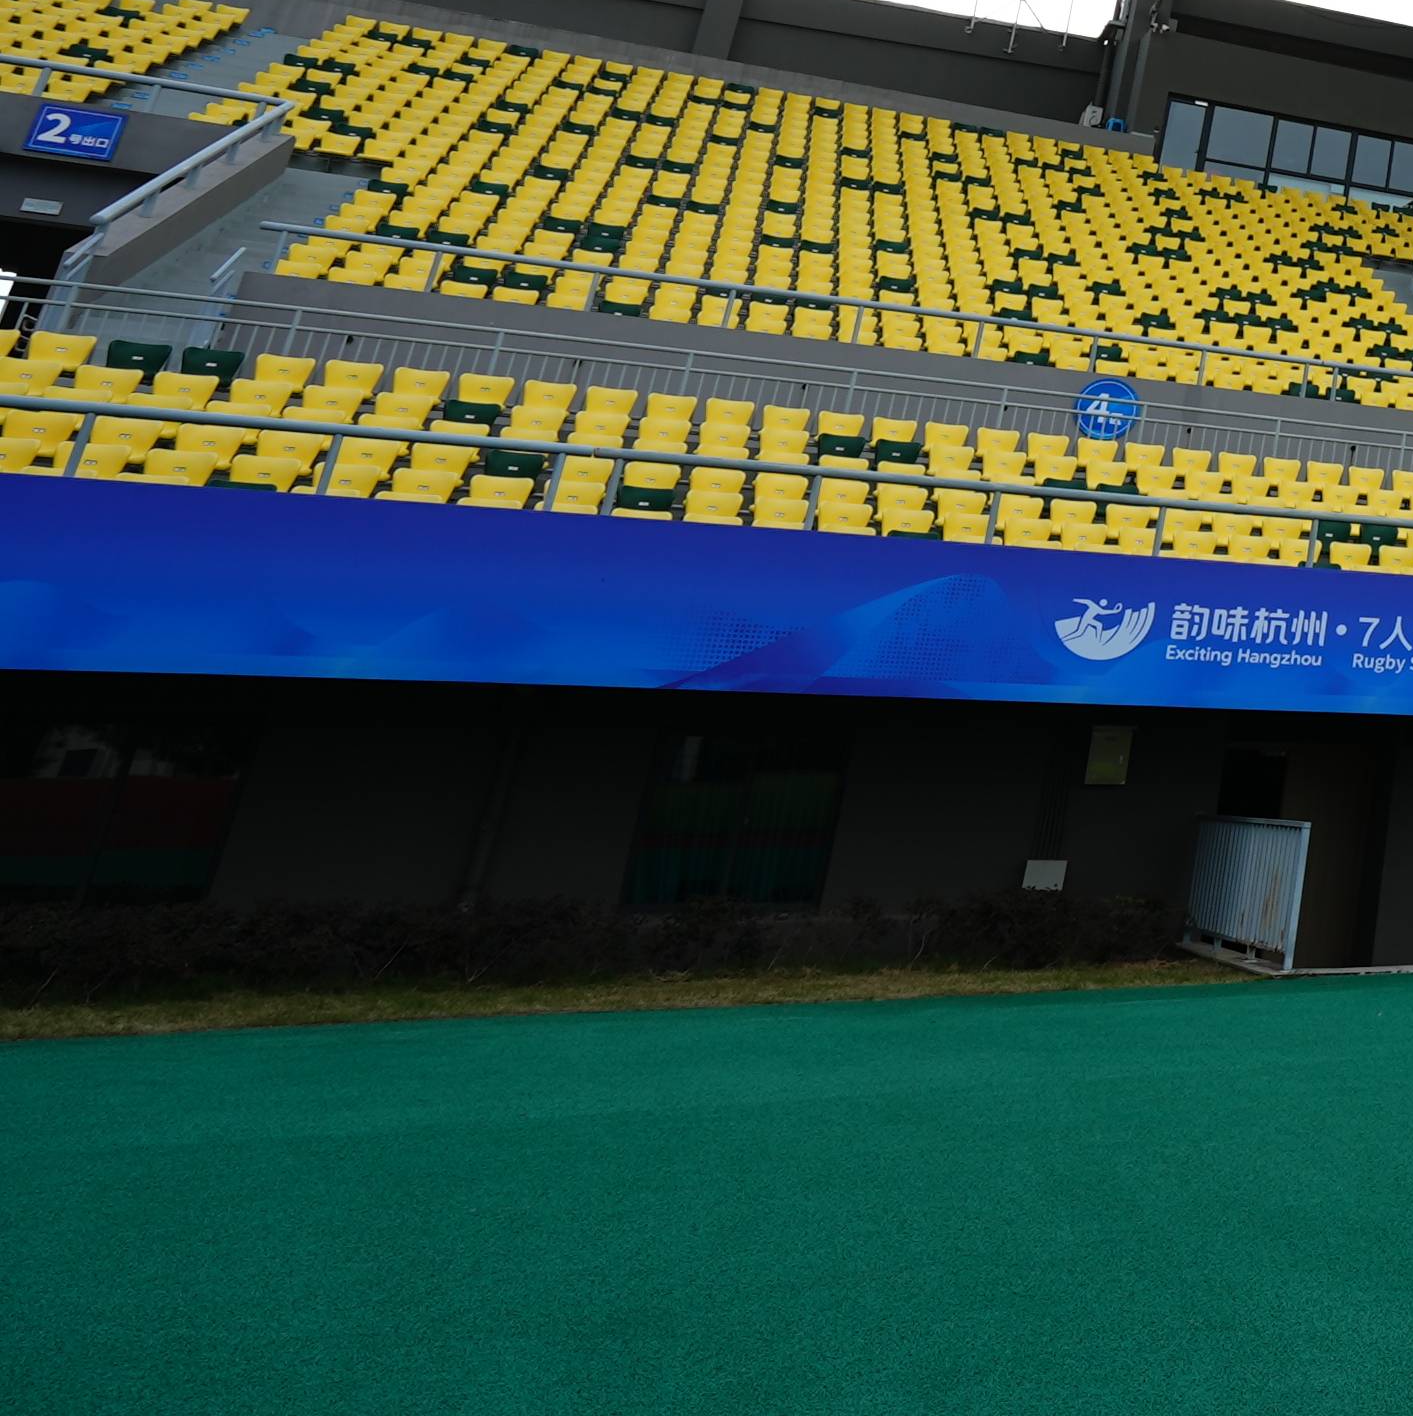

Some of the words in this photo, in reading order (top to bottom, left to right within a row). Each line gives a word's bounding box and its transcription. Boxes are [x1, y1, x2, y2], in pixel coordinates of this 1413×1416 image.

[37, 113, 110, 149] 2号出口
[1166, 645, 1232, 666] Exciting
[1237, 648, 1322, 668] Hangzhou
[1352, 653, 1406, 674] Rugby
